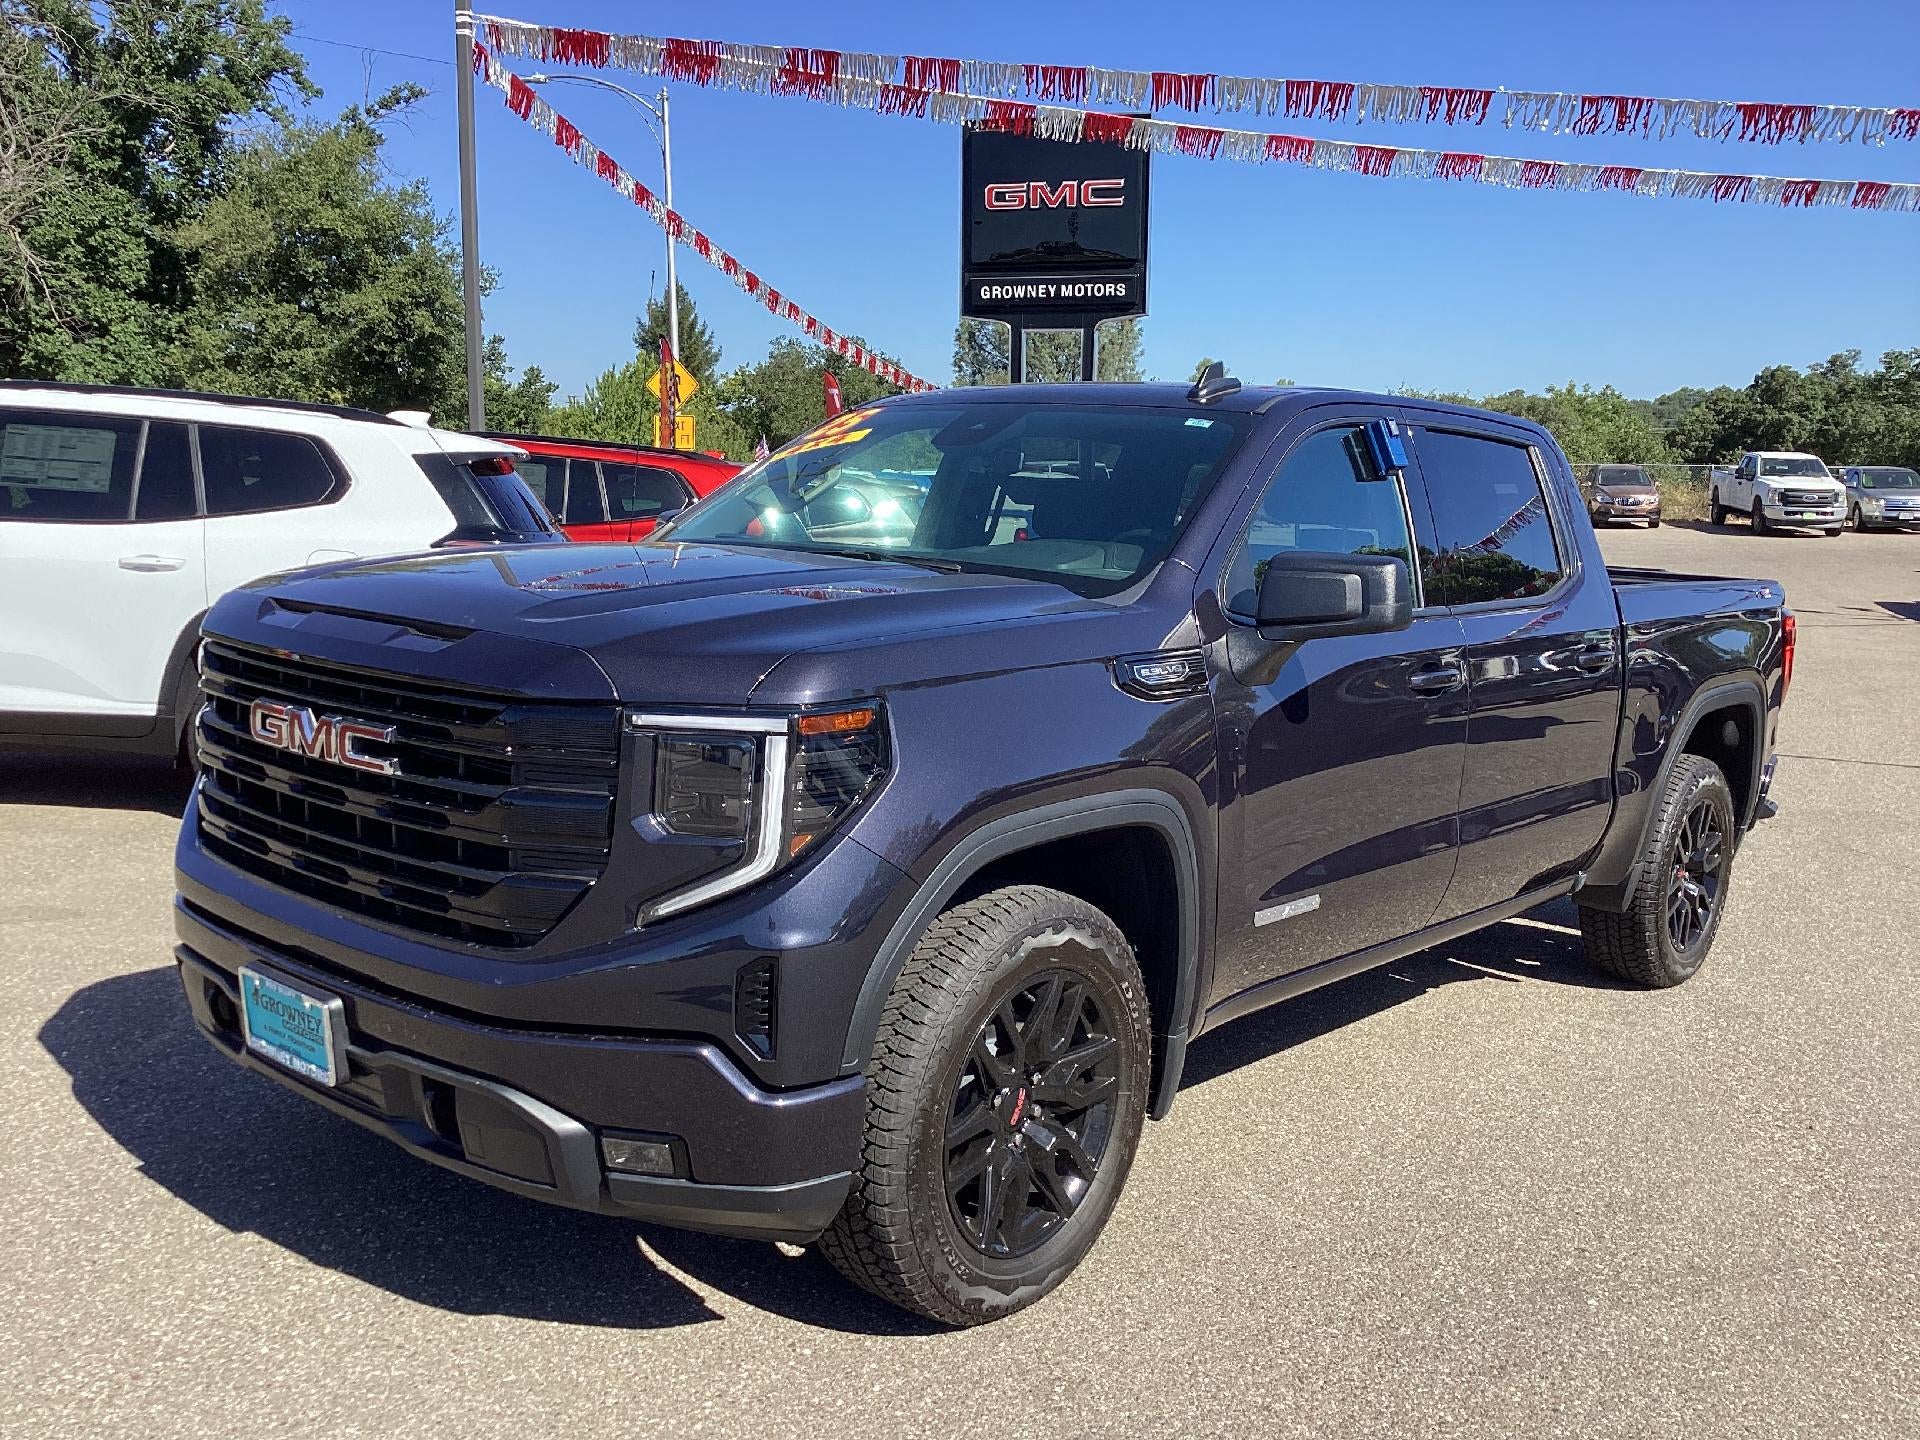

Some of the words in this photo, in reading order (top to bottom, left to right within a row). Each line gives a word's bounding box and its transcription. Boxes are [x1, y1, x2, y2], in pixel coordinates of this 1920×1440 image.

[984, 178, 1126, 210] GMC
[980, 284, 1057, 299] GROWNEY
[1060, 283, 1126, 297] MOTORS
[251, 697, 401, 775] GMC
[260, 993, 322, 1034] GROWNEY
